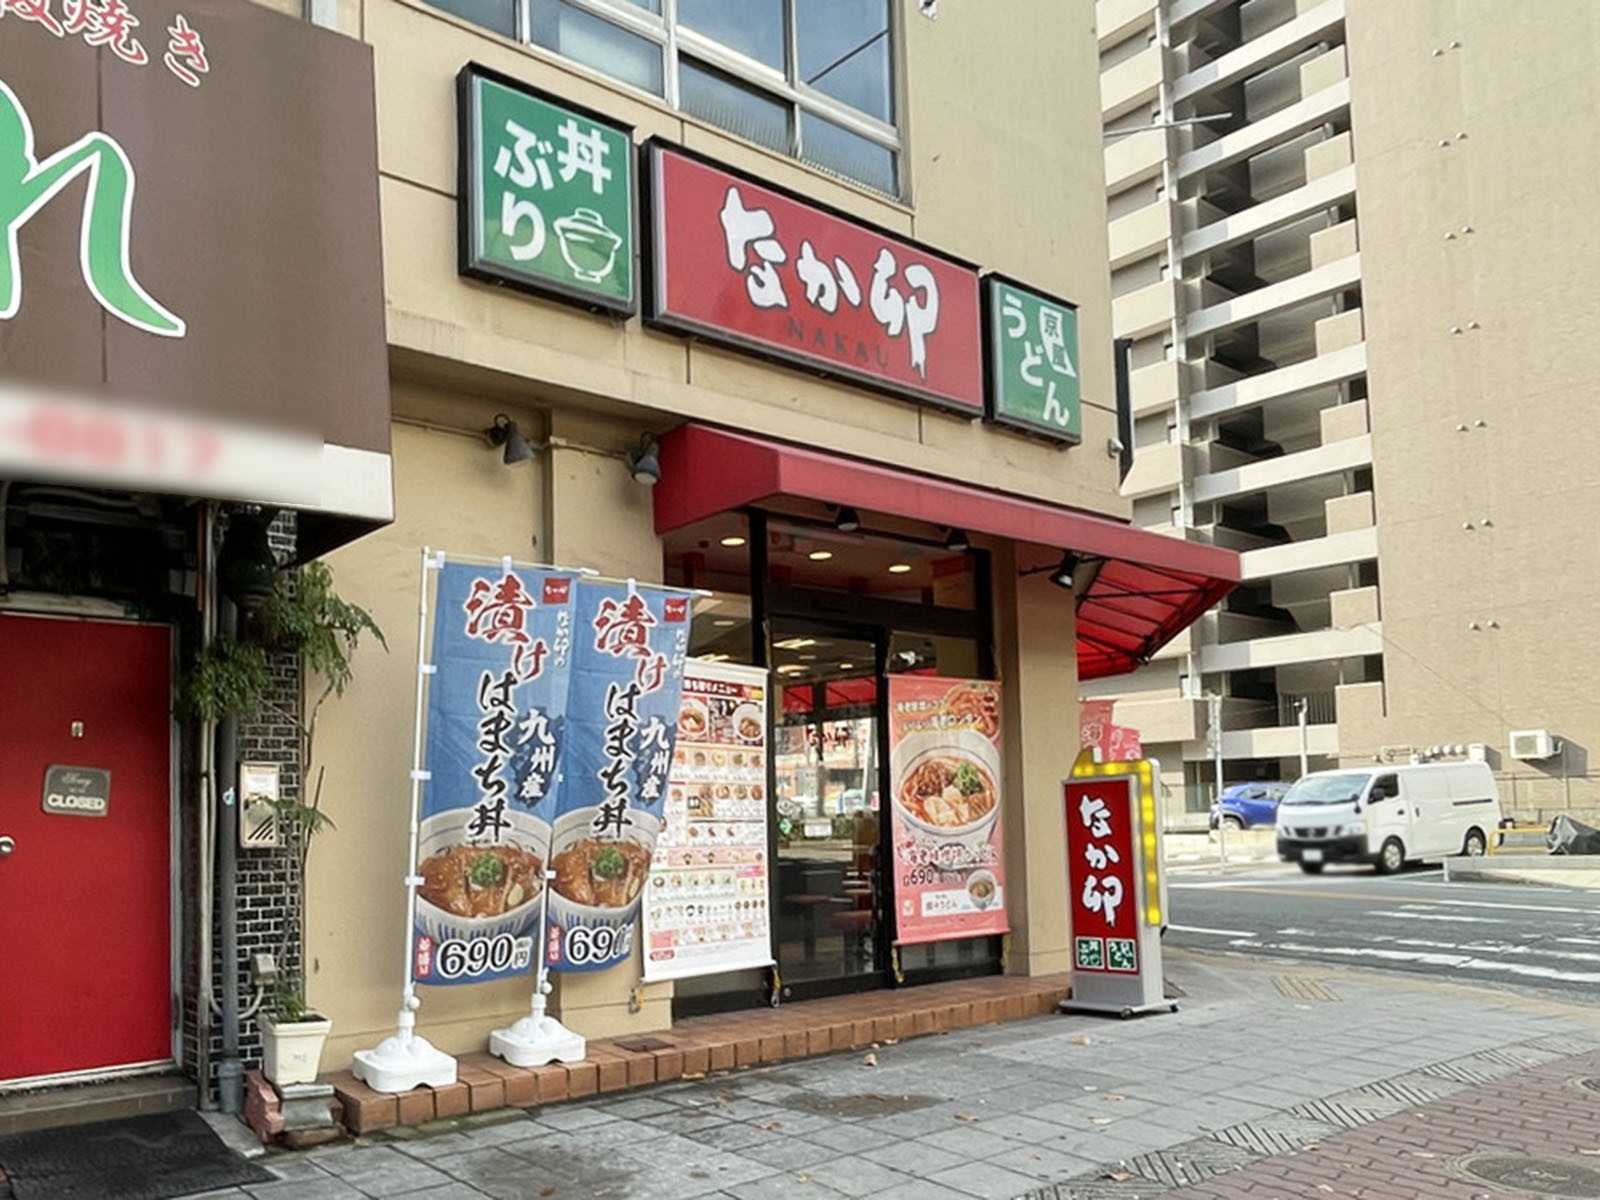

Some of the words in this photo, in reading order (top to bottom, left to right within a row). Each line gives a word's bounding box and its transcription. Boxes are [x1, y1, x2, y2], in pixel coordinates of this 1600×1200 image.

[719, 186, 940, 378] なか卯
[786, 317, 889, 367] NAKAU
[518, 708, 555, 799] 九州産
[47, 793, 105, 810] CLOSED
[1079, 795, 1123, 927] なか卯
